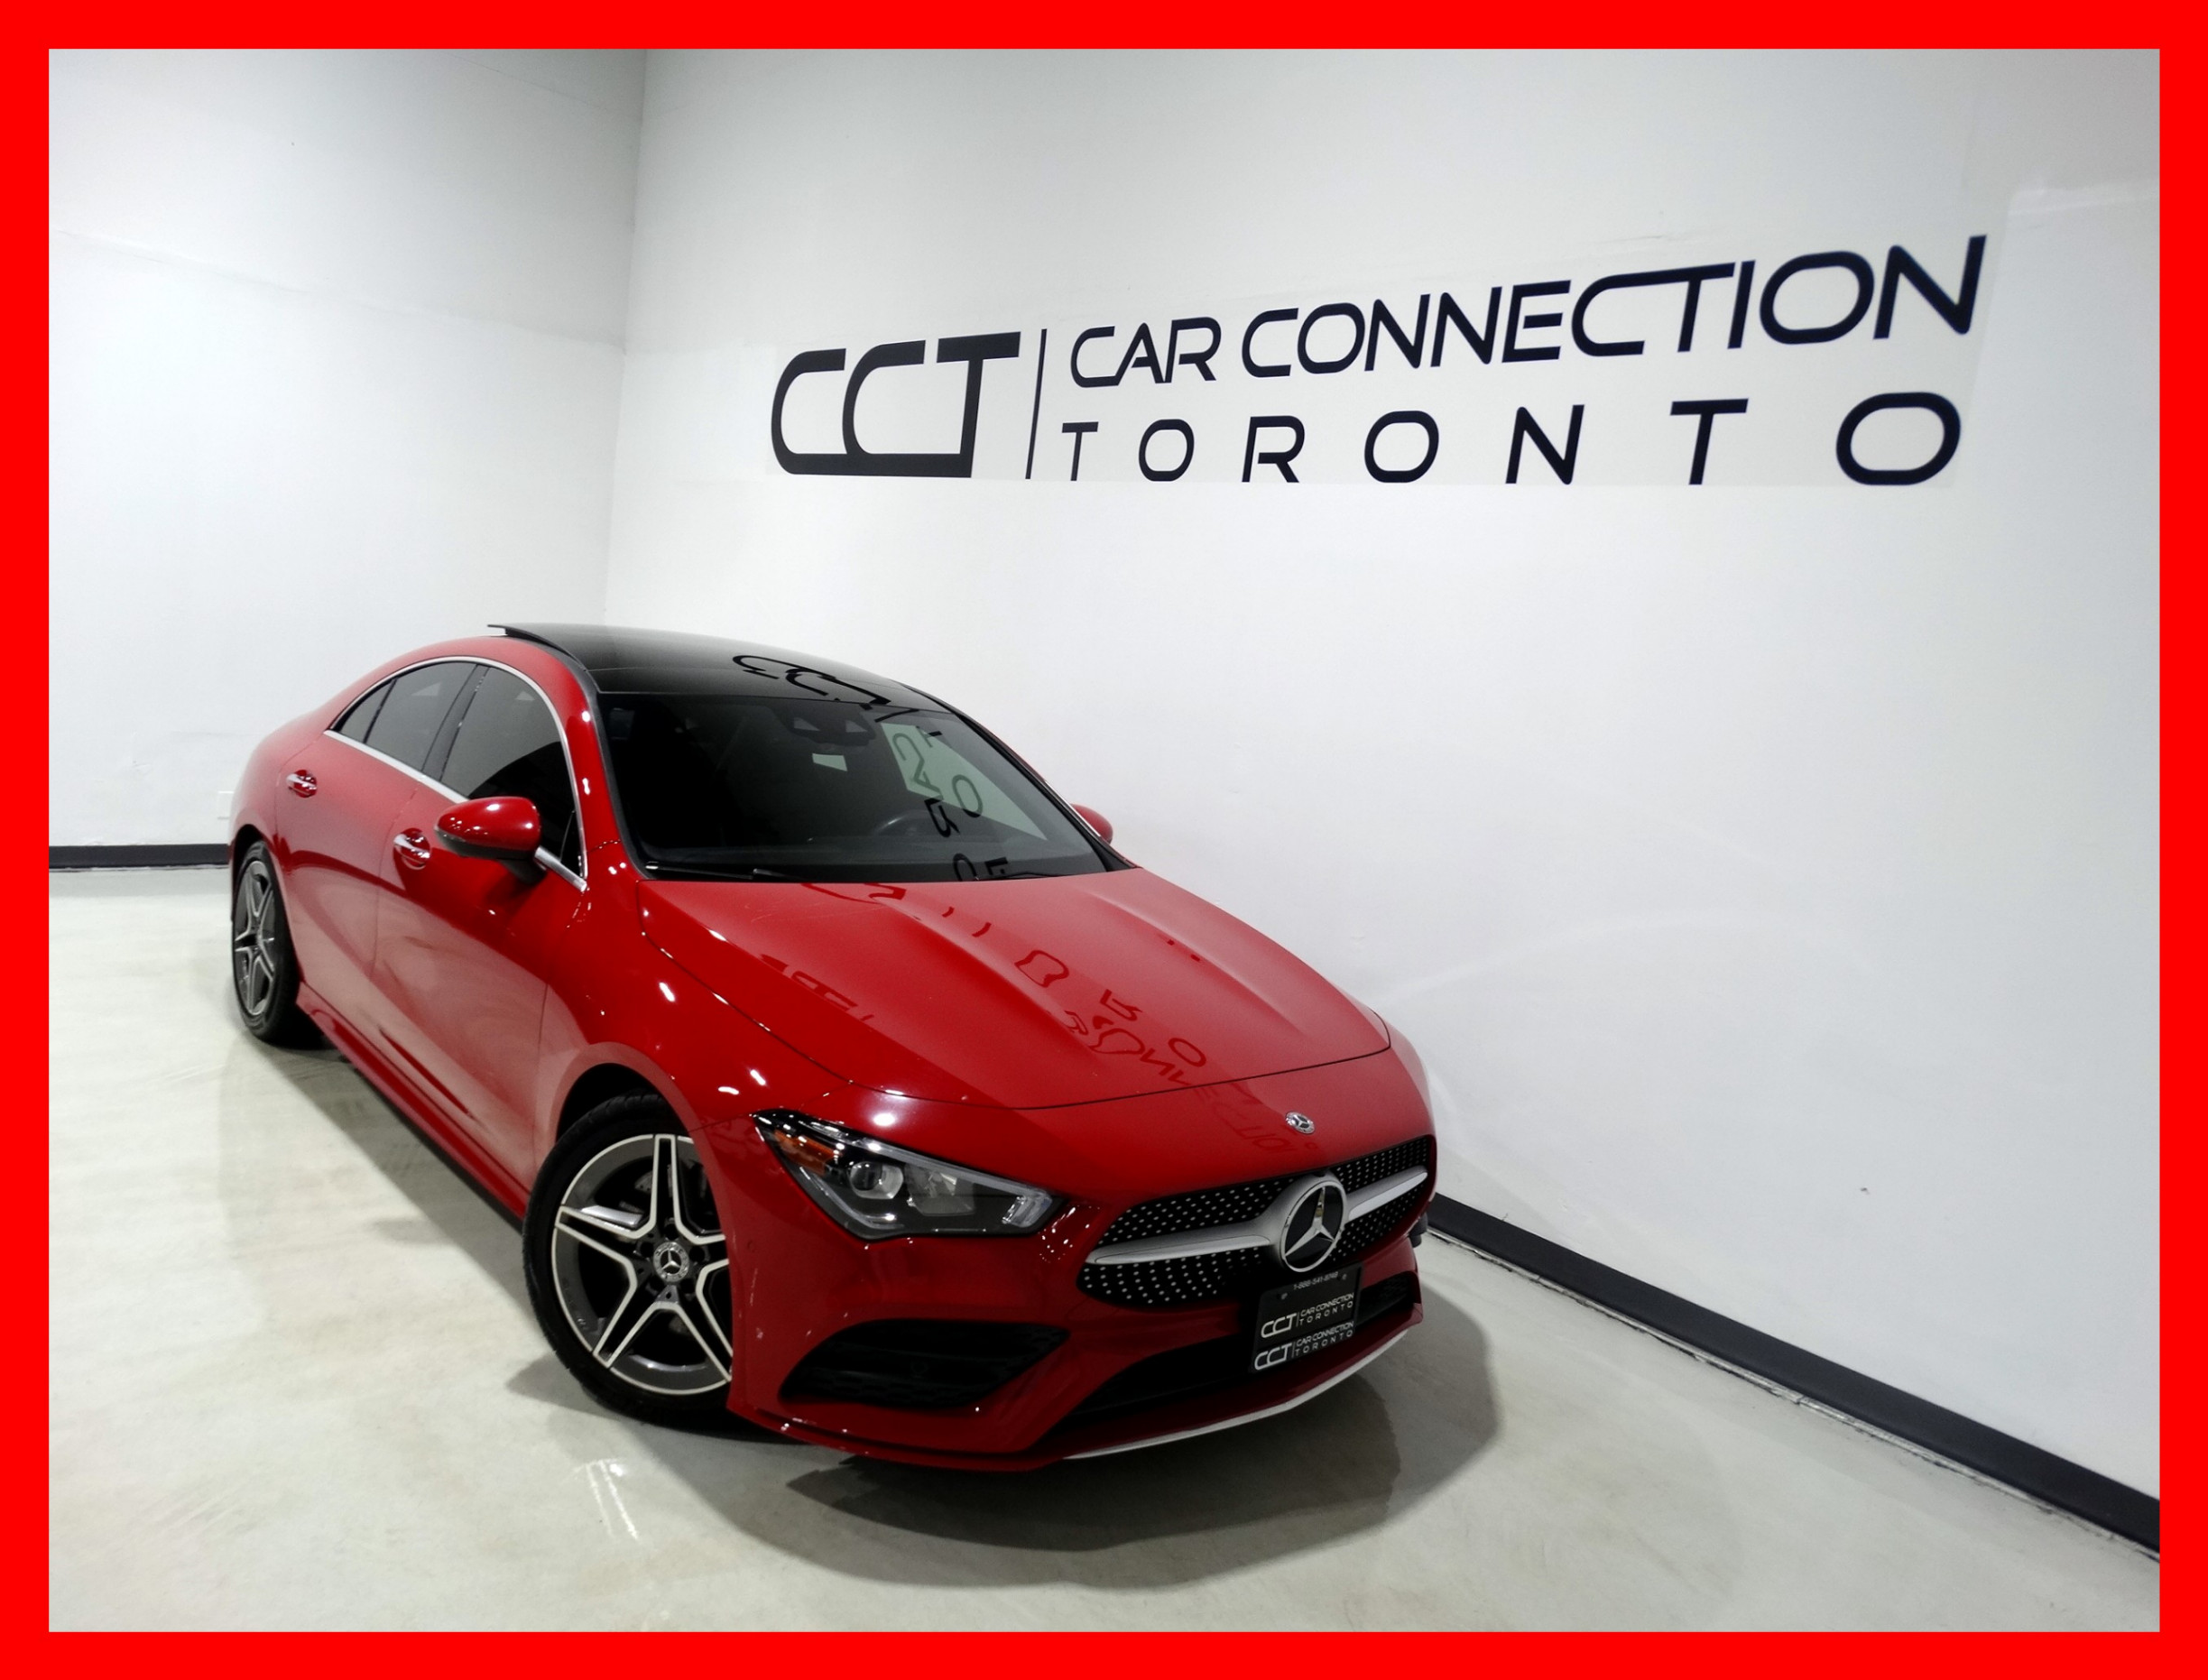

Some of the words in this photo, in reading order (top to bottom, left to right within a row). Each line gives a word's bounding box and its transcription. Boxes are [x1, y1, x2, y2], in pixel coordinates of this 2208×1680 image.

[1070, 317, 1222, 388] CAR
[1242, 235, 1987, 378] CONNECTION
[771, 331, 1021, 478] CCT
[1061, 392, 1962, 486] TORONTO
[1299, 1306, 1316, 1317] CAR
[1316, 1292, 1354, 1312] CONNECTION
[1299, 1300, 1353, 1326] TORONTO
[1261, 1313, 1297, 1338] CCT
[1296, 1336, 1312, 1347] CAR
[1312, 1321, 1354, 1342] CONNECTION
[1254, 1343, 1292, 1371] CCT
[1295, 1330, 1353, 1357] TORONTO
